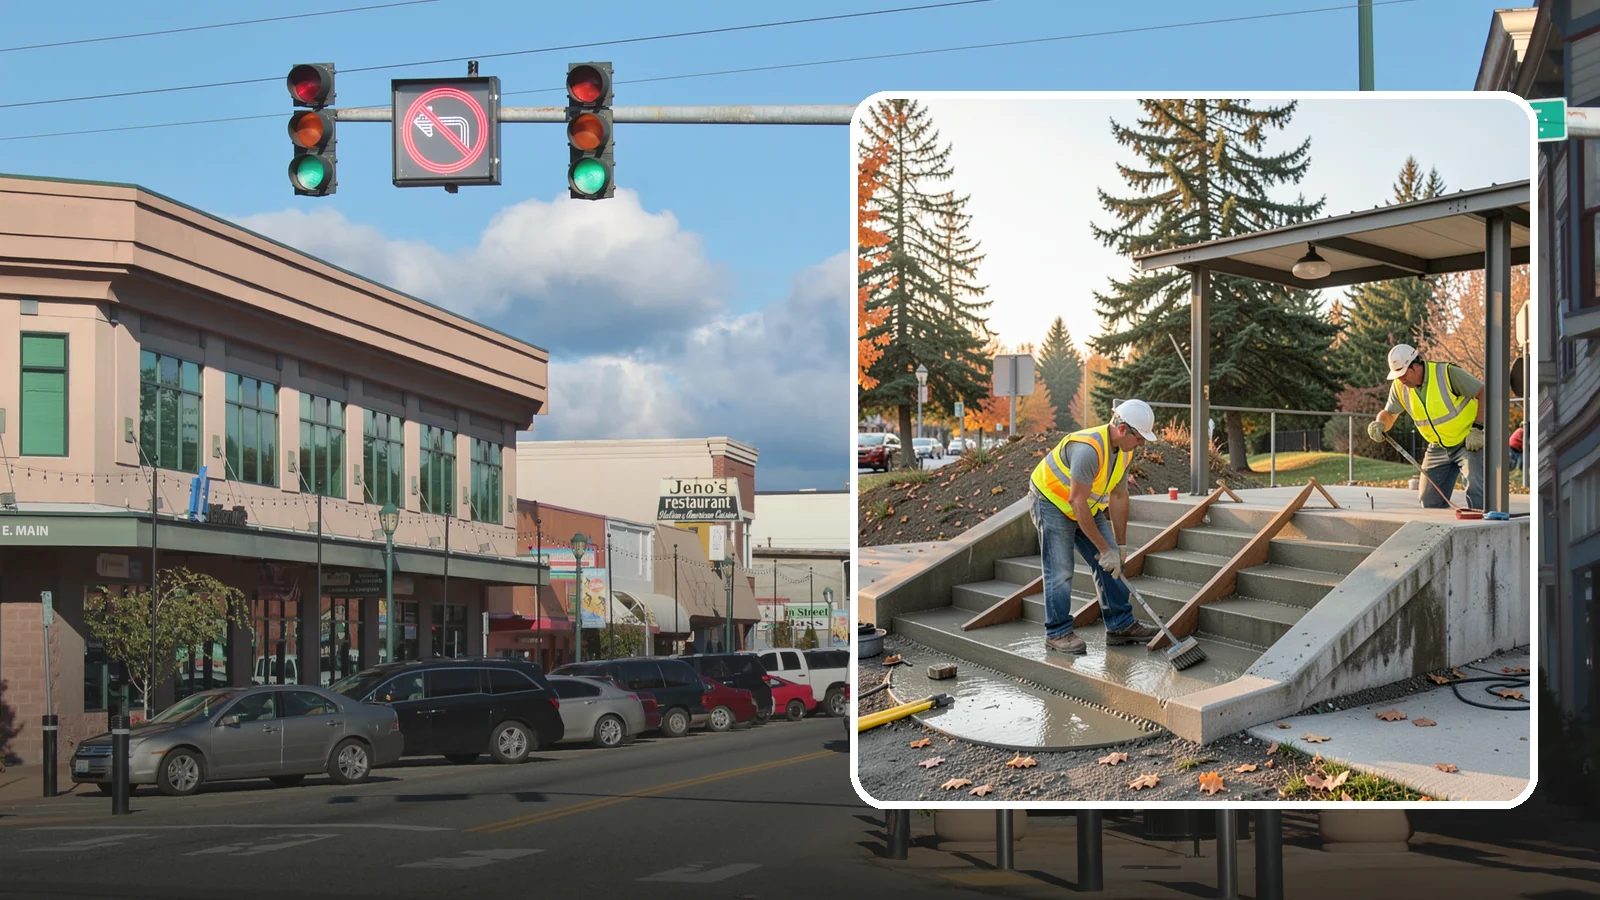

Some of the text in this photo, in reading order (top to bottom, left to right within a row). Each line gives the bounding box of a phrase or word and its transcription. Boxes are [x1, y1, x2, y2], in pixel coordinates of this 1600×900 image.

[669, 480, 728, 494] Jeno's
[665, 496, 731, 509] restaurant
[658, 510, 681, 520] Italian
[686, 510, 714, 519] American
[715, 510, 738, 519] Cuisine
[2, 525, 49, 536] E. MAIN
[797, 608, 828, 616] Street
